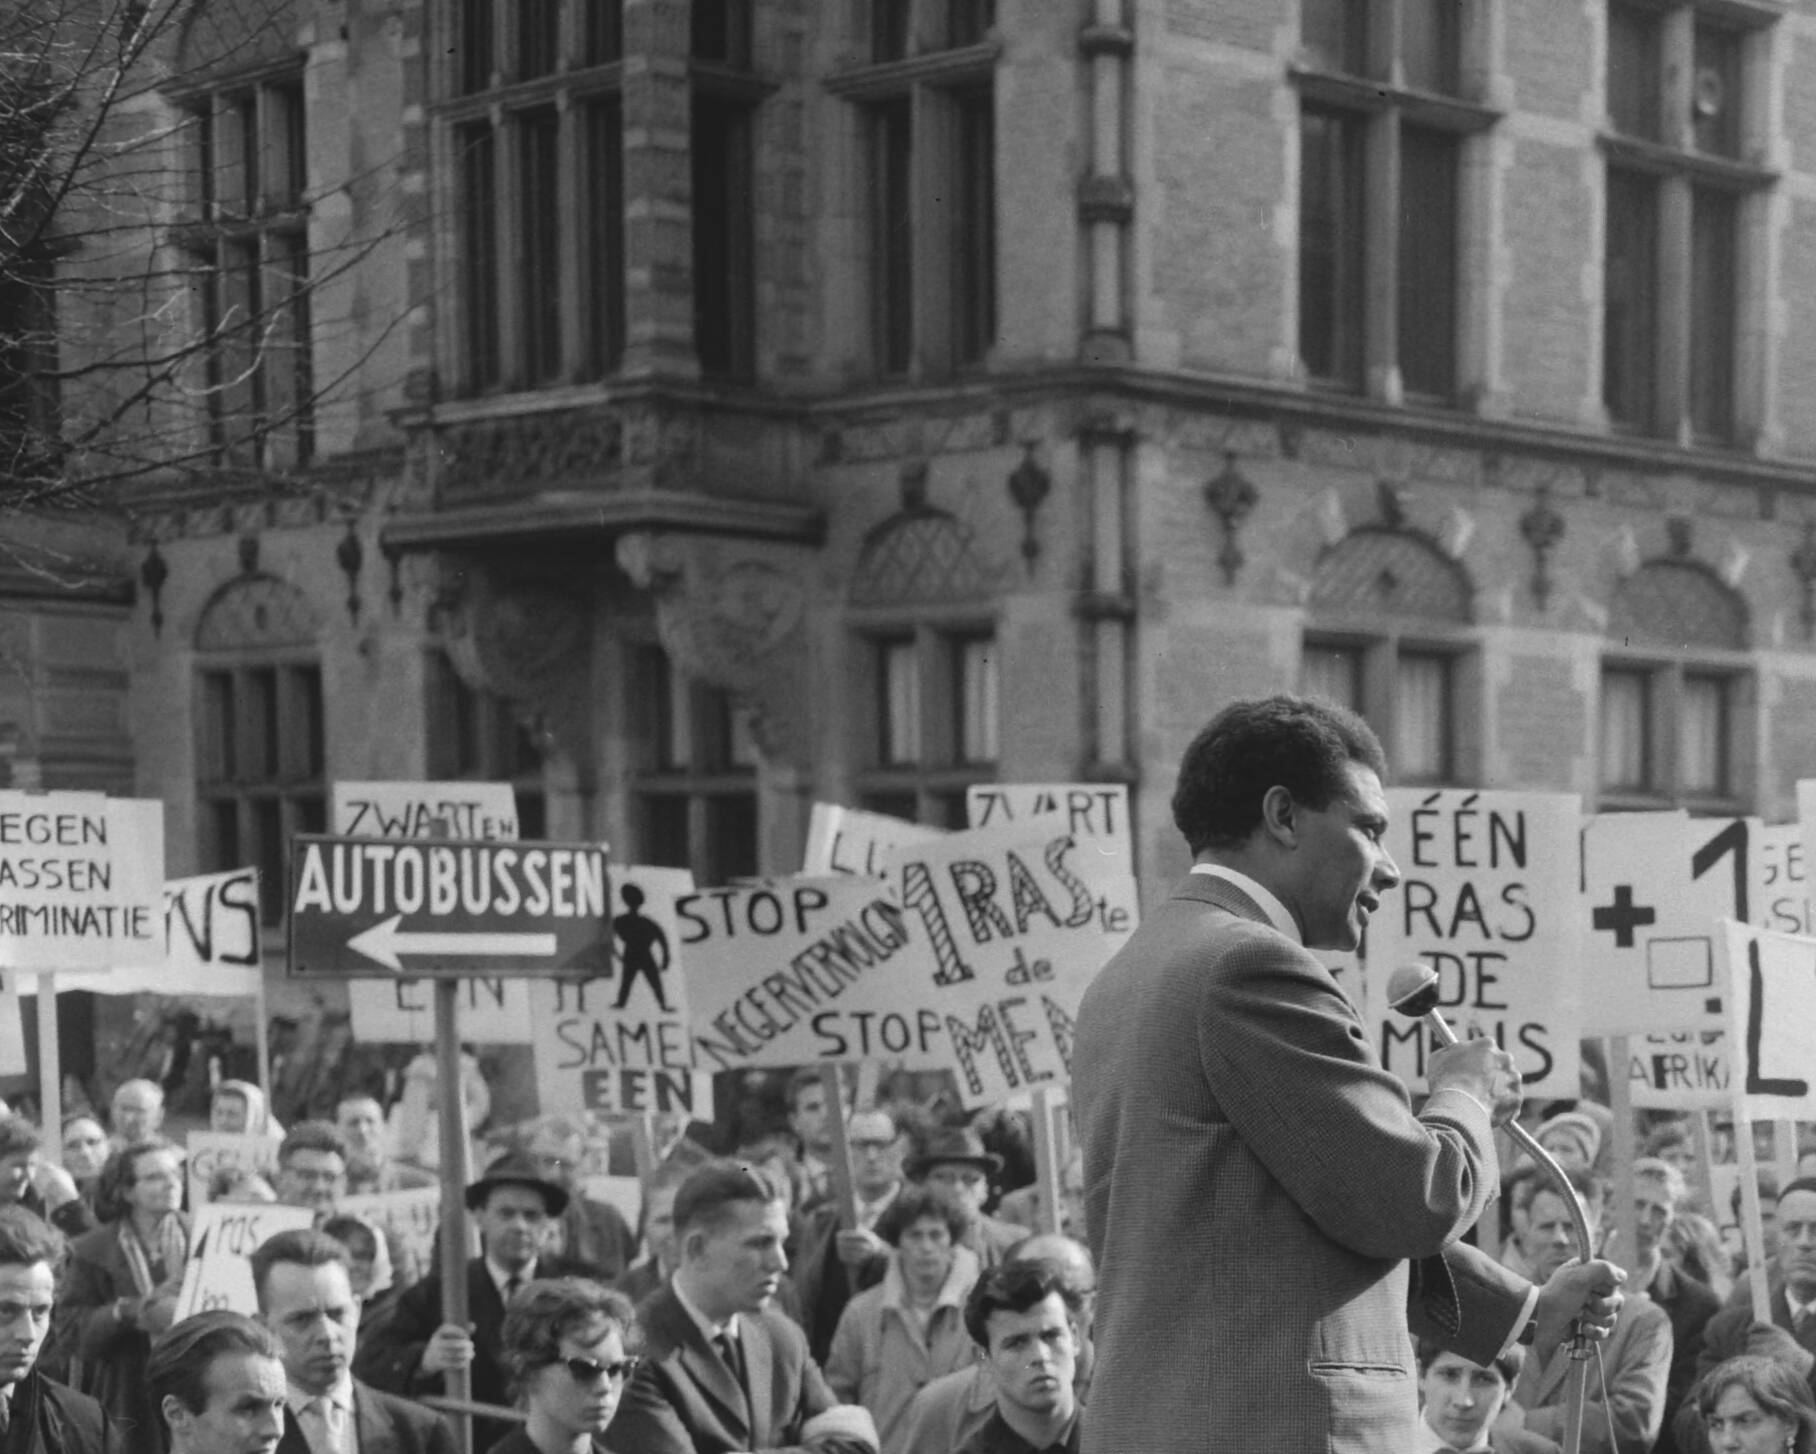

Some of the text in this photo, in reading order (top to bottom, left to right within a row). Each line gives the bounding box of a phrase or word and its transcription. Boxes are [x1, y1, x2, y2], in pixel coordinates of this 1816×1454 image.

[1410, 793, 1527, 868] ÉÉN
[294, 843, 604, 917] AUTOBUSSEN
[676, 886, 829, 944] STOP
[1403, 881, 1536, 942] RAS
[1004, 946, 1056, 986] de
[1419, 951, 1509, 1009] DE
[811, 1008, 941, 1056] STOP
[1382, 1020, 1554, 1085] MS
